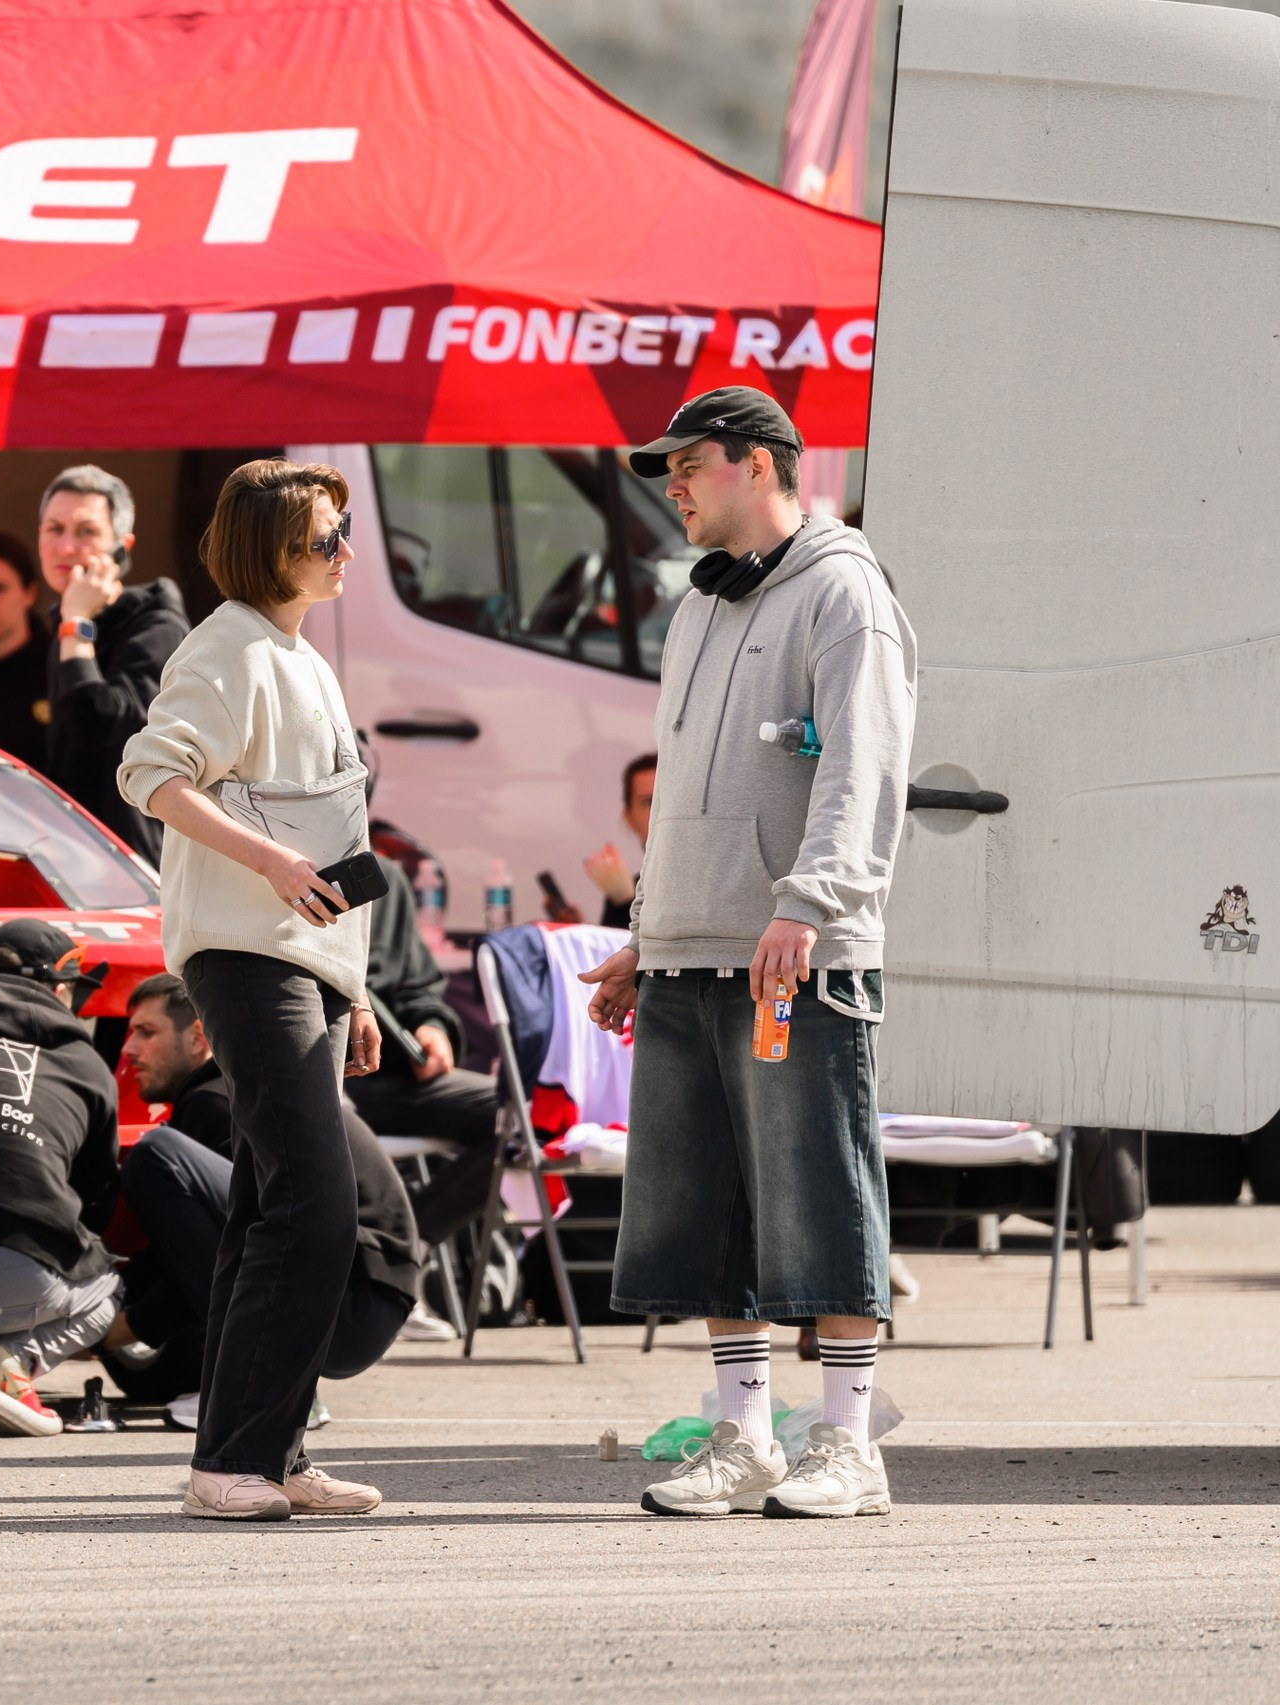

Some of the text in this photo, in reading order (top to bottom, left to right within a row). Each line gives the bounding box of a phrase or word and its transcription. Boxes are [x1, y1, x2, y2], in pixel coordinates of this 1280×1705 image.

[426, 306, 715, 365] FONBET
[1200, 929, 1260, 954] TDI
[1, 1103, 34, 1124] Bad
